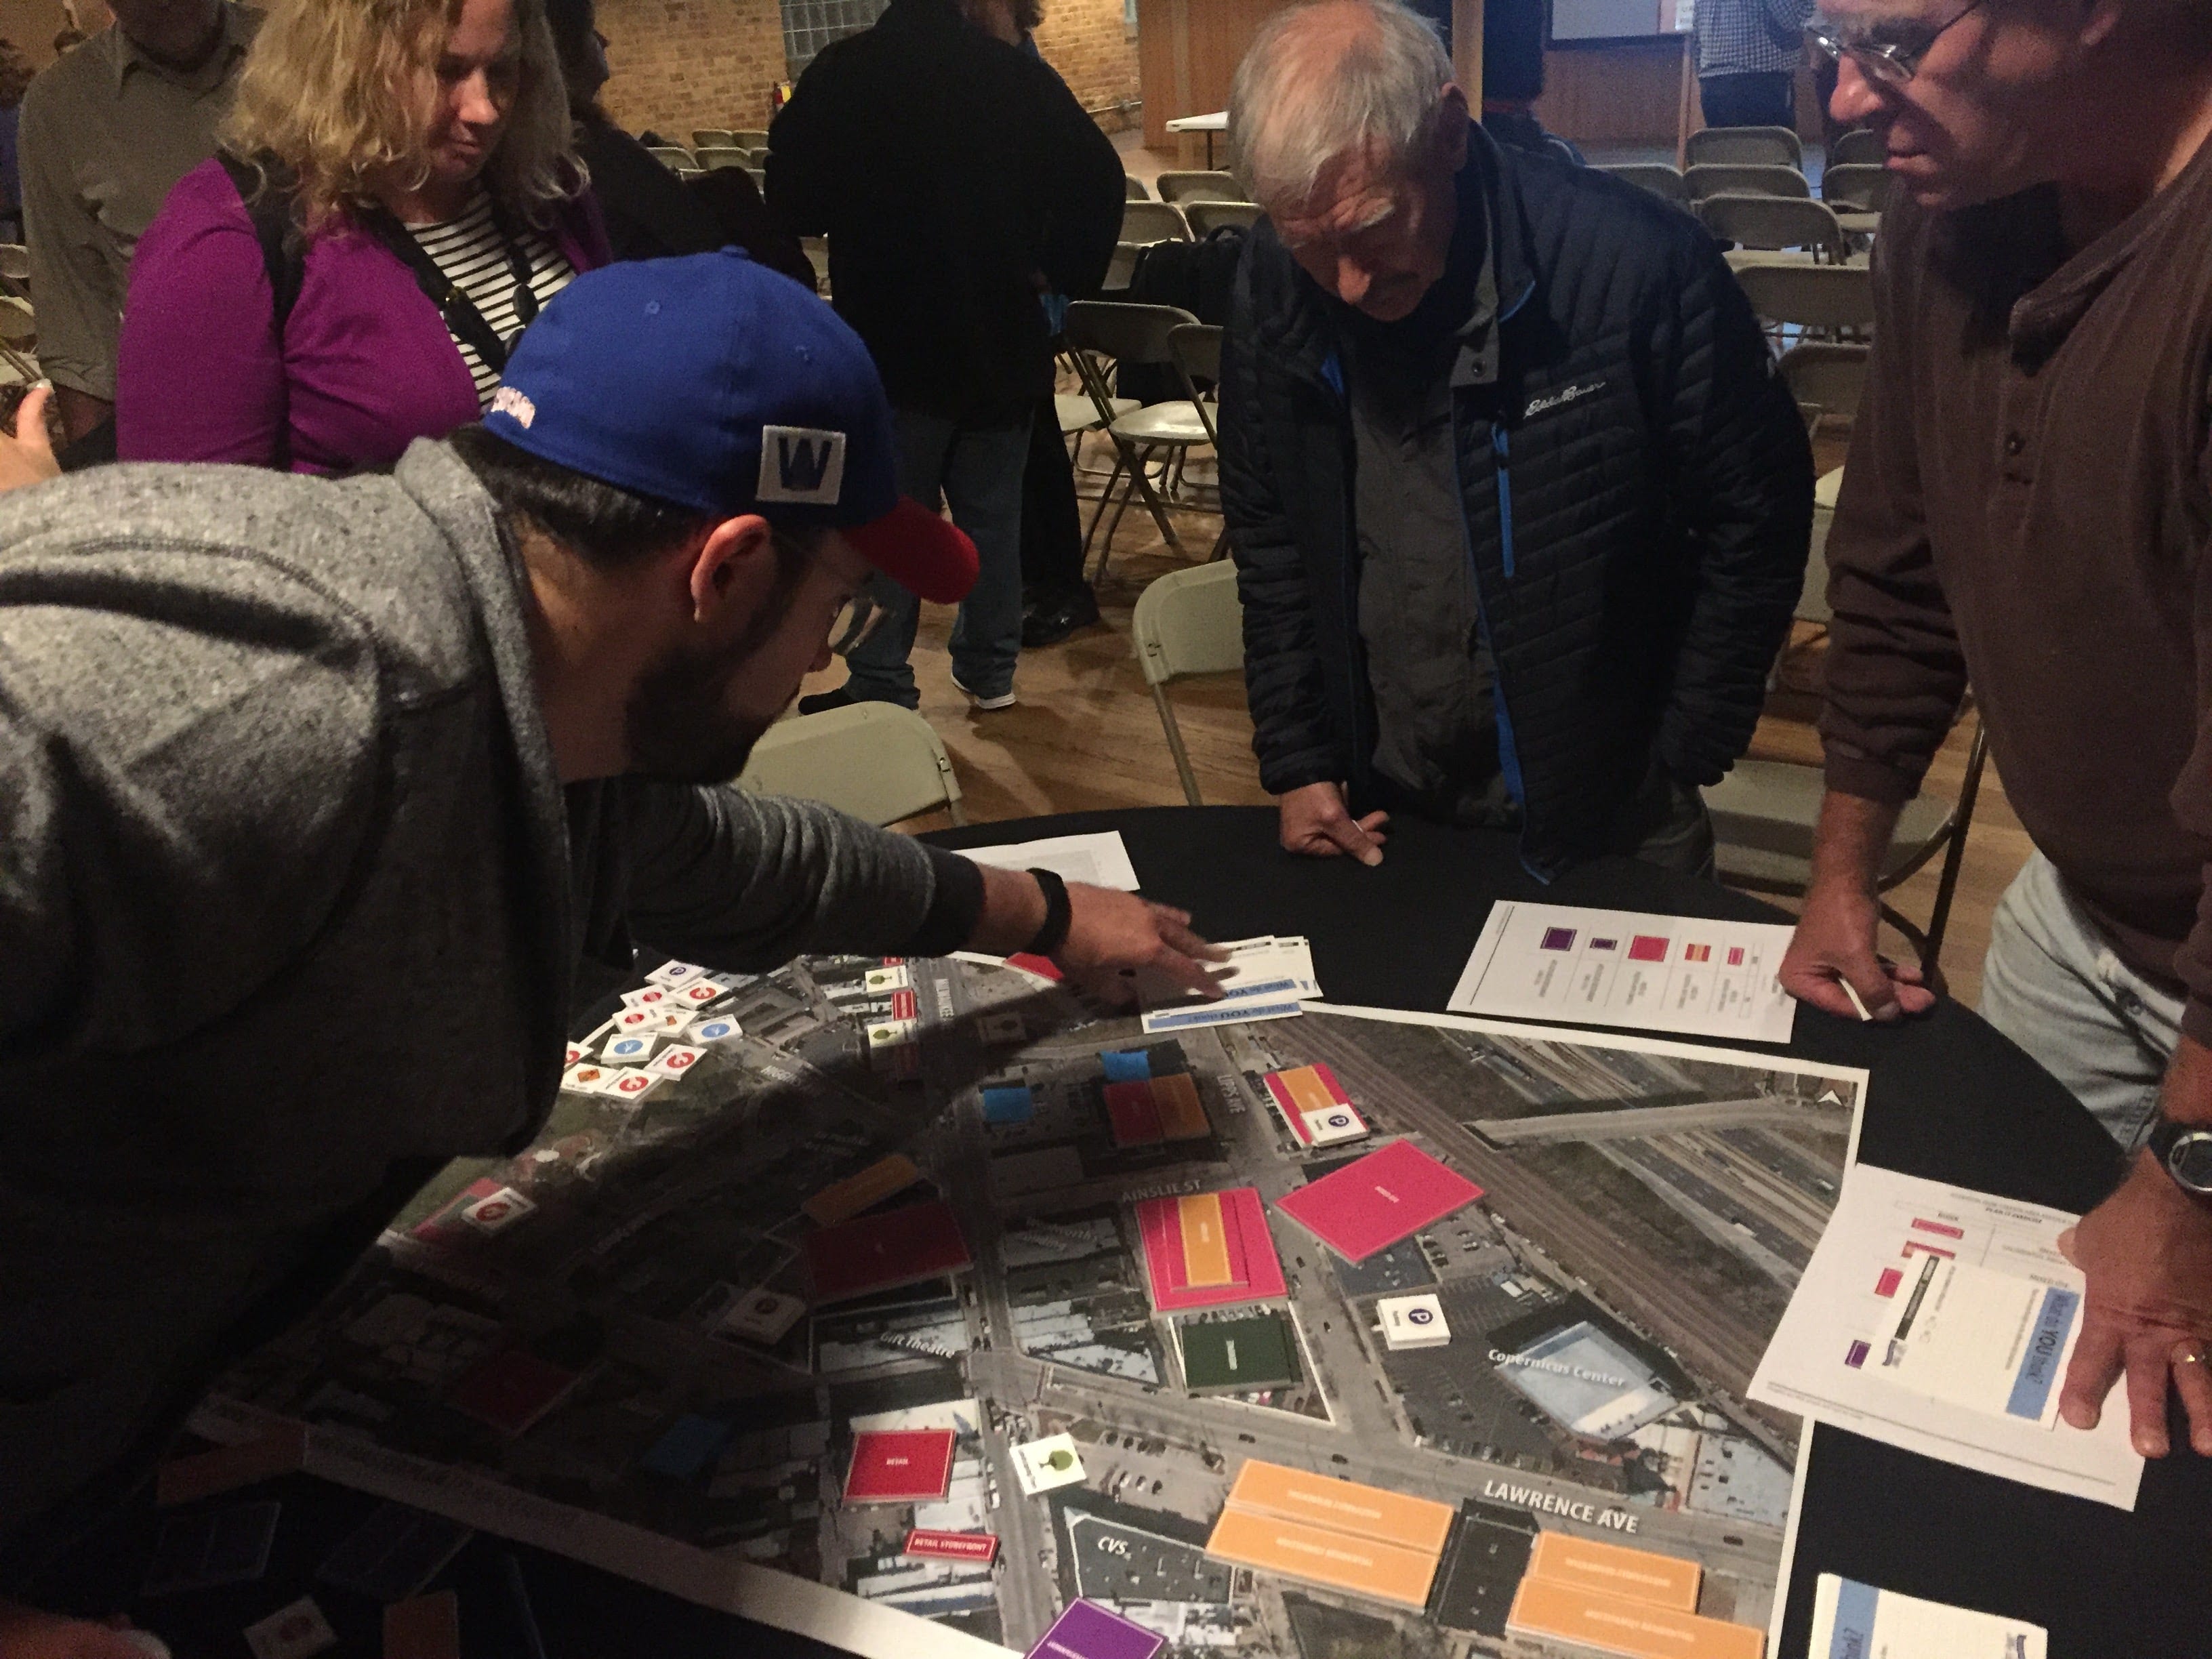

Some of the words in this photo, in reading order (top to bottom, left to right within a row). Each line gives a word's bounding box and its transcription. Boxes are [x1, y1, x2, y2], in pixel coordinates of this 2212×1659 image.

[777, 436, 833, 491] W
[1221, 1009, 1250, 1019] YOU
[1330, 1116, 1348, 1126] P
[1122, 1184, 1180, 1202] AINSLIE
[1184, 1179, 1200, 1191] ST
[1410, 1311, 1432, 1324] P
[906, 1334, 956, 1359] Theatre
[2035, 1329, 2060, 1356] YOU
[1488, 1349, 1570, 1374] Copernicus
[1573, 1366, 1626, 1387] Center
[1484, 1480, 1595, 1523] LAWRENCE
[1597, 1509, 1639, 1534] AVE
[1098, 1536, 1128, 1555] CVS
